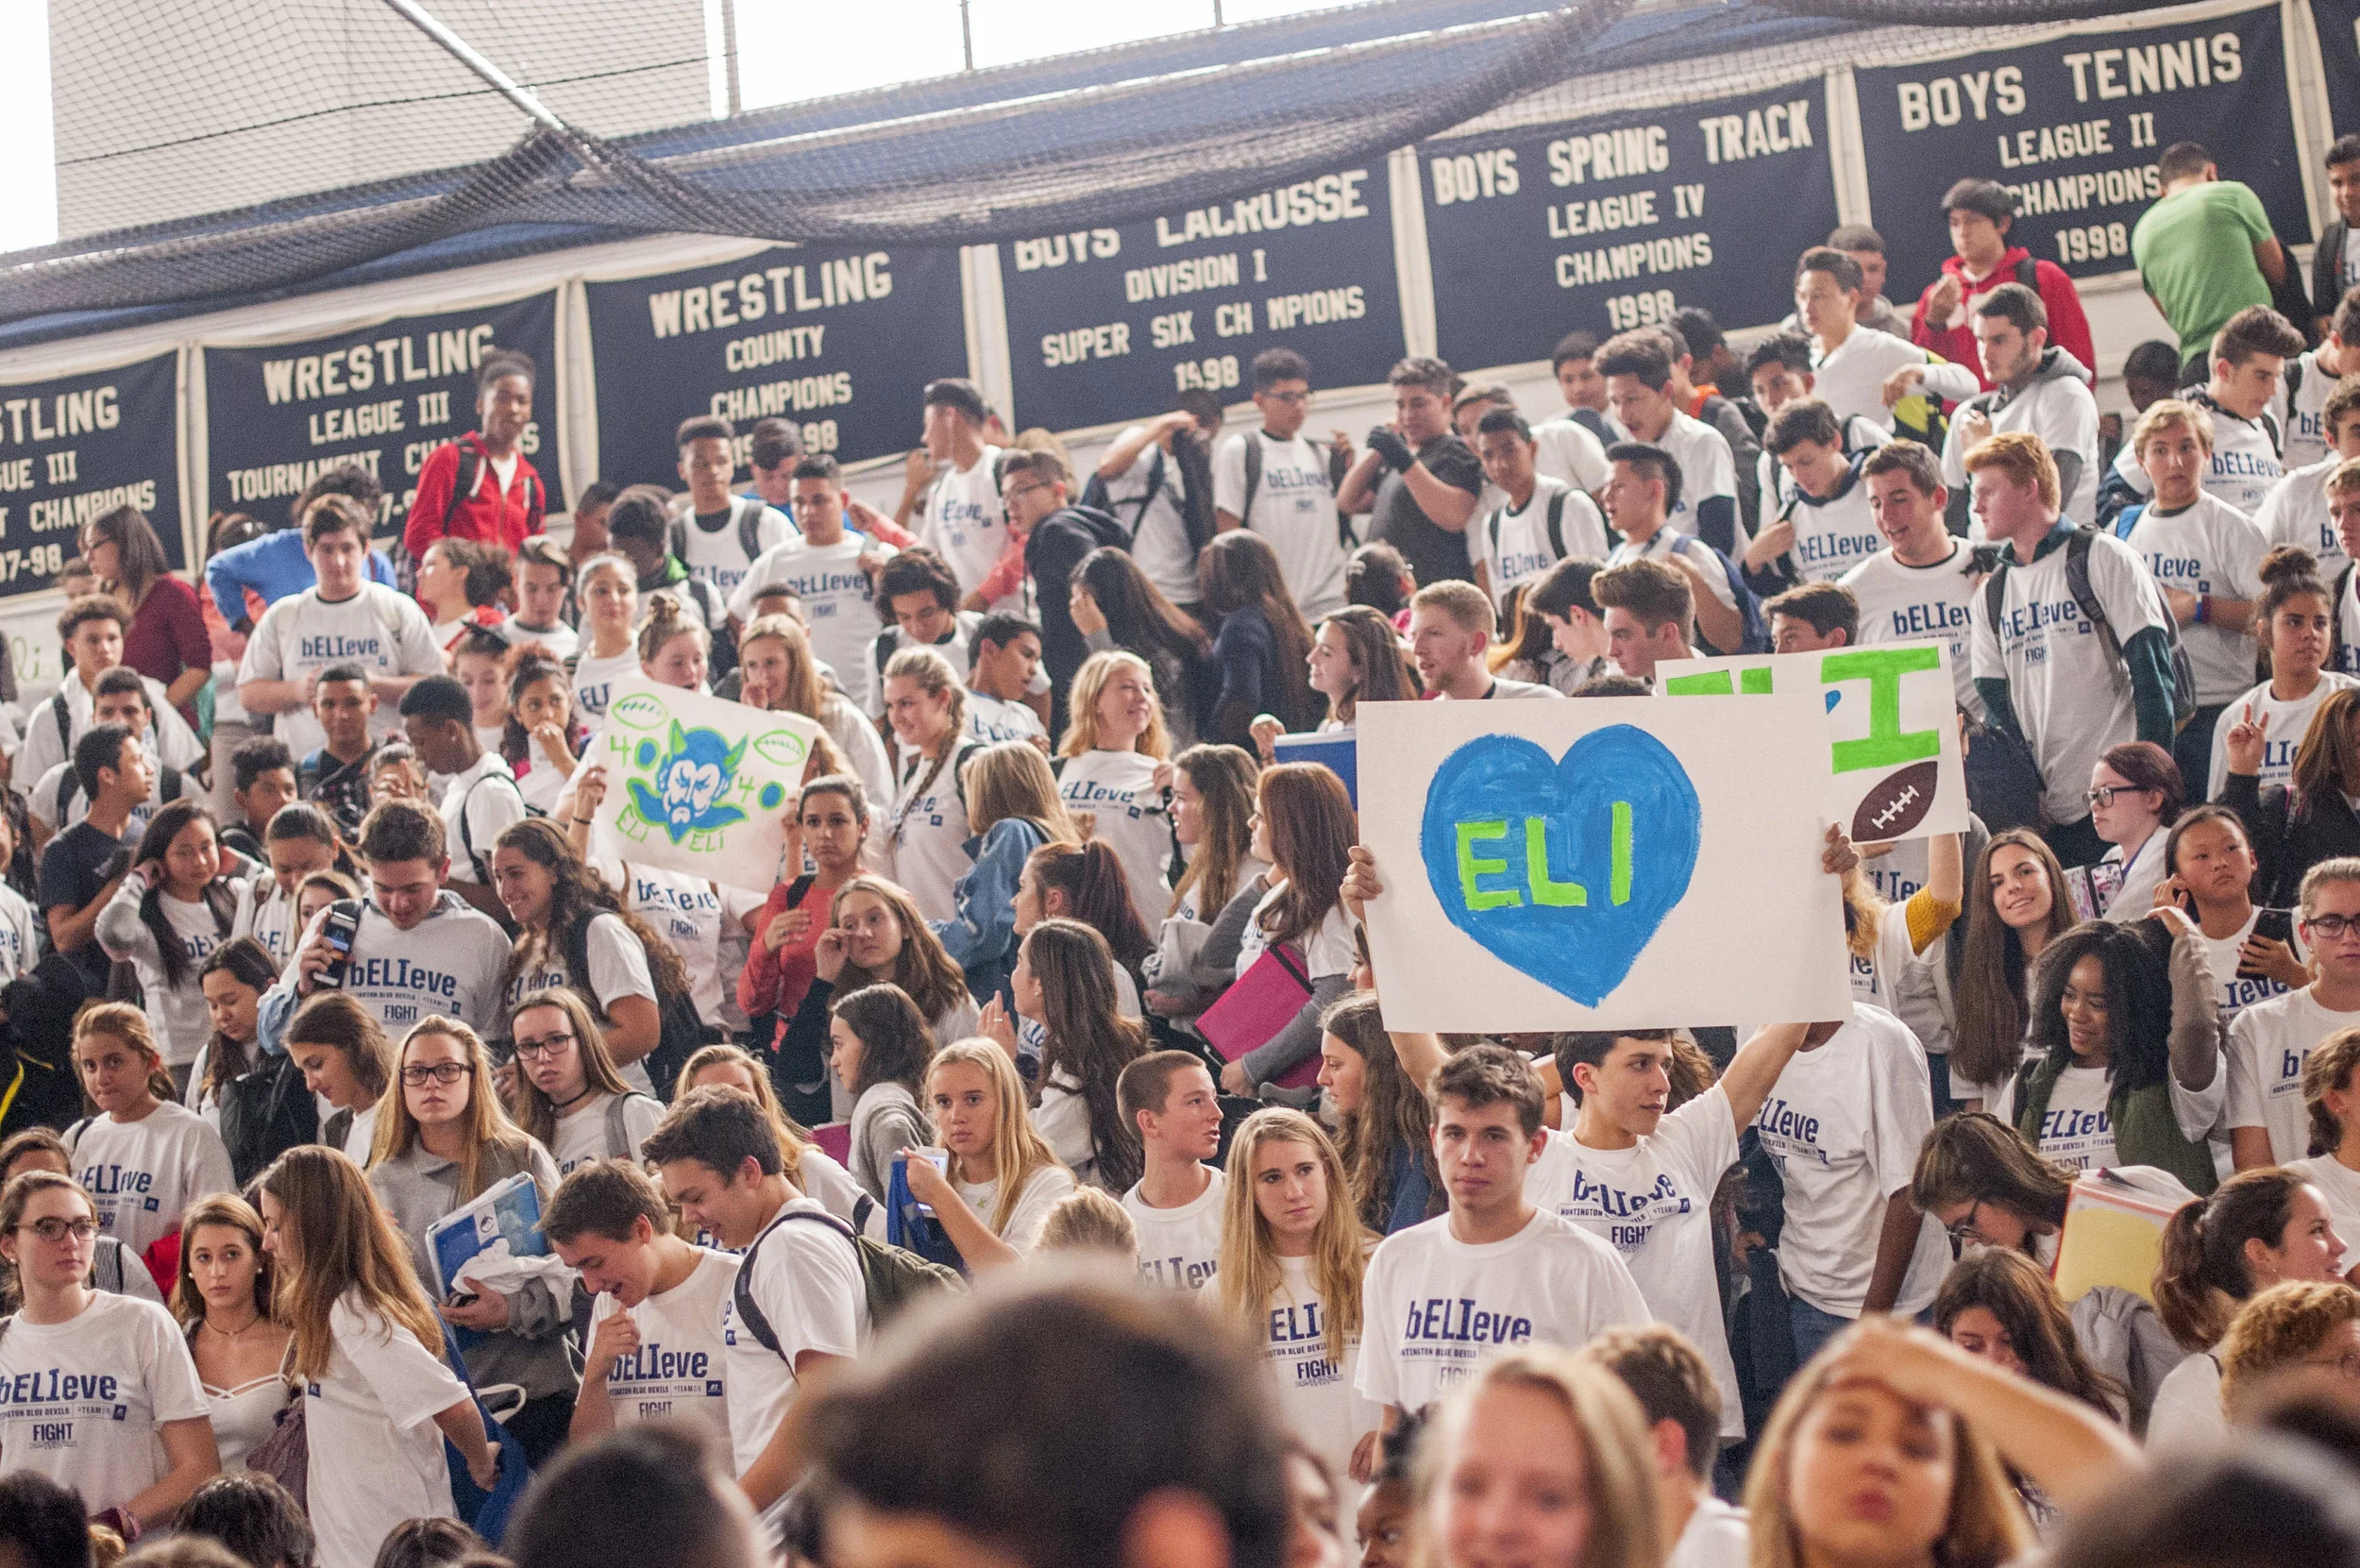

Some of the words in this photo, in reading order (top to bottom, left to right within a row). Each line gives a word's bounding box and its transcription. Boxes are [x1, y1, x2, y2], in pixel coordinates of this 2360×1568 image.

[1896, 65, 2027, 132] BOYS
[2063, 32, 2244, 103] TENNIS
[1430, 148, 1520, 206] BOYS
[1546, 125, 1670, 188] SPRING
[1698, 99, 1814, 164] TRACK
[1998, 117, 2114, 169] LEAGUE
[2129, 111, 2157, 148] II
[1547, 190, 1660, 240] LEAGUE
[1673, 183, 1705, 220] IV
[1556, 232, 1713, 289] CHAMPIONS
[2054, 222, 2131, 265] 1998
[649, 251, 893, 339] WRESTLING
[1124, 253, 1239, 303] DIVISION
[1252, 248, 1268, 283] I
[1605, 289, 1677, 331] 1998
[263, 324, 495, 404] WRESTLING
[726, 325, 825, 373] COUNTY
[1041, 323, 1131, 368] SUPER
[1151, 311, 1196, 349] SIX
[0, 385, 121, 445] TLING
[310, 399, 405, 446] LEAGUE
[418, 391, 450, 427] III
[710, 372, 853, 423] CHAMPIONS
[46, 450, 77, 485] III
[1798, 532, 1878, 563] bELIeve
[302, 634, 379, 659] bELIeve
[1455, 801, 1633, 911] ELI
[350, 958, 458, 998] bELIeve
[384, 1004, 418, 1020] FIGHT
[1405, 1298, 1532, 1346] bELIeve
[1288, 1346, 1305, 1355] BLUE
[632, 1385, 647, 1394] BLUE
[649, 1385, 669, 1394] DEVILS
[33, 1423, 74, 1442] FIGHT
